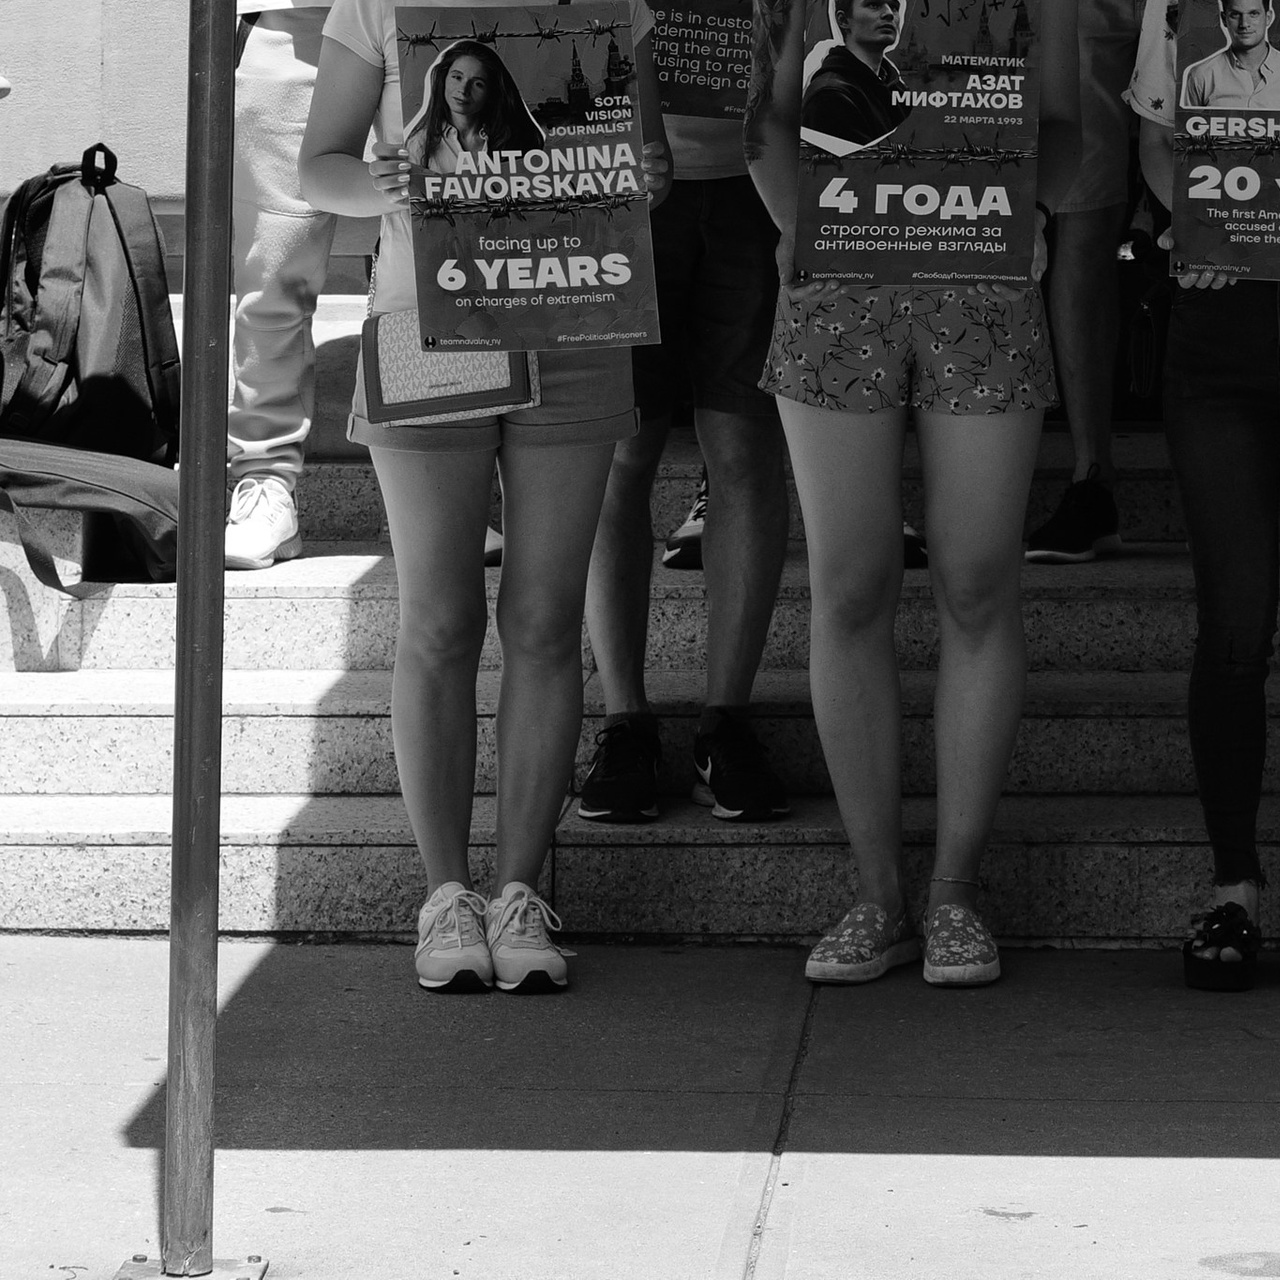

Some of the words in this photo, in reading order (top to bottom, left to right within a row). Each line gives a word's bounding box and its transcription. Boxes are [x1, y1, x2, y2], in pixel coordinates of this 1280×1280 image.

[671, 11, 682, 21] is
[688, 12, 702, 24] in
[652, 26, 728, 45] ndemning
[685, 43, 710, 56] the
[705, 59, 722, 71] to
[941, 55, 1025, 67] МАТЕМАТИК
[674, 71, 732, 89] foreign
[966, 74, 1025, 90] АЗАТ
[594, 95, 631, 108] SOTA
[891, 91, 1023, 109] МИФТАХОВ
[585, 108, 632, 120] VISION
[959, 116, 995, 124] МАРТА
[997, 116, 1023, 125] 1993
[548, 122, 632, 137] JOURNALIST
[455, 142, 636, 175] ANTONINA
[424, 169, 639, 199] FAVORSKAYA
[1188, 165, 1261, 201] 20
[819, 178, 858, 213] 4
[875, 184, 1012, 220] ГОДА
[1207, 208, 1229, 219] The
[1232, 208, 1255, 219] first
[820, 225, 900, 239] строгого
[905, 226, 976, 240] режима
[982, 227, 1002, 237] за
[1225, 222, 1276, 233] accused
[478, 236, 531, 253] facing
[537, 238, 558, 251] up
[564, 235, 581, 248] to
[814, 239, 933, 251] антивоенные
[938, 240, 1007, 252] взгляды
[1230, 234, 1261, 244] since
[436, 258, 467, 291] 6
[474, 252, 632, 290] YEARS
[455, 296, 472, 307] on
[475, 294, 526, 308] charges
[530, 293, 543, 306] of
[547, 292, 615, 305] extremism
